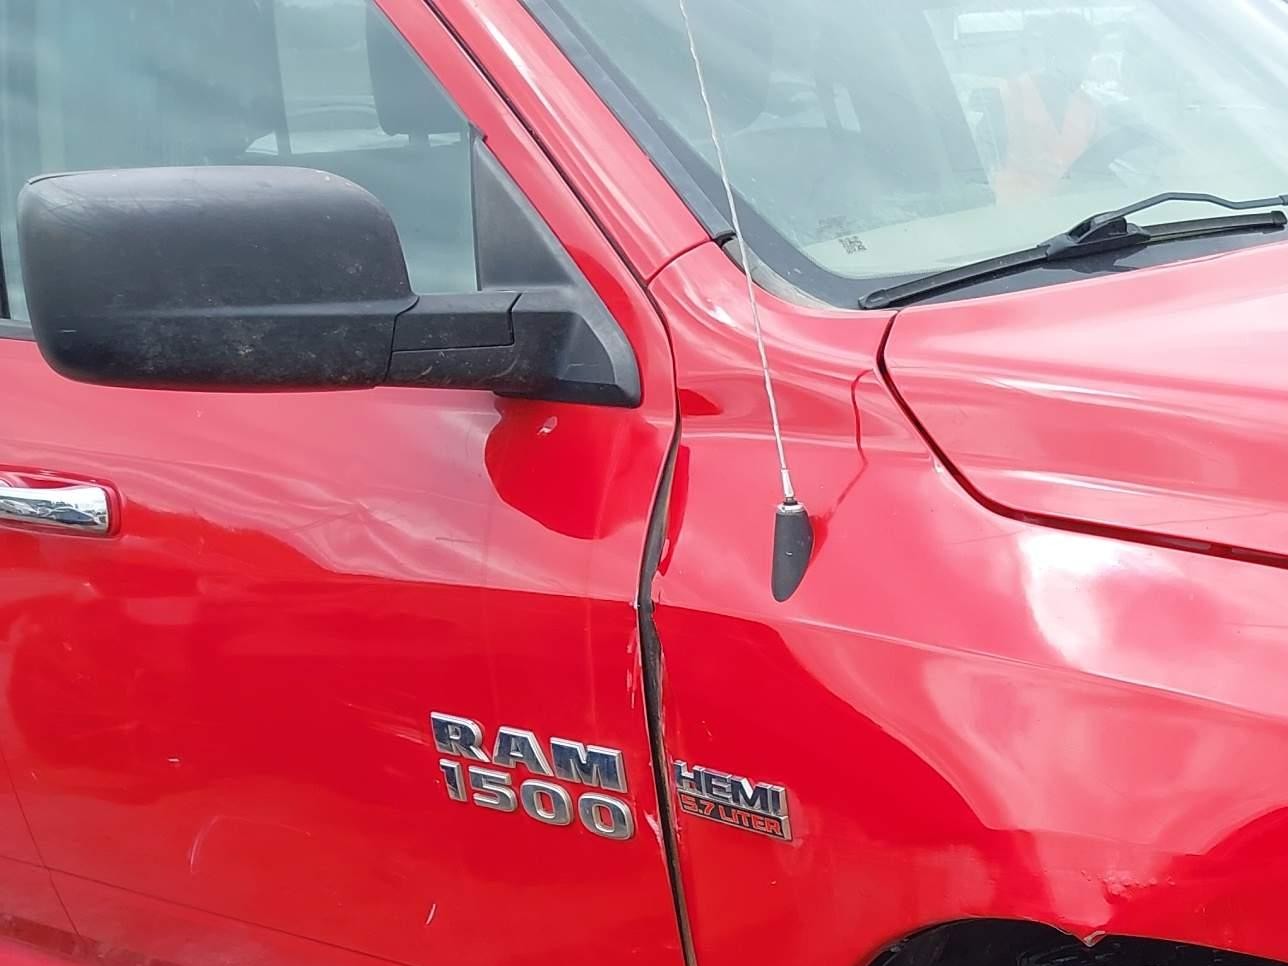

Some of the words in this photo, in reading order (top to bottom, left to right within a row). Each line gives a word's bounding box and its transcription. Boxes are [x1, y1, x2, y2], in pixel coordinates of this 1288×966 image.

[430, 711, 627, 792] RAM
[439, 759, 634, 841] 1500
[674, 760, 787, 817] HEMI
[680, 794, 715, 815] 5.7
[718, 805, 781, 833] LITER
